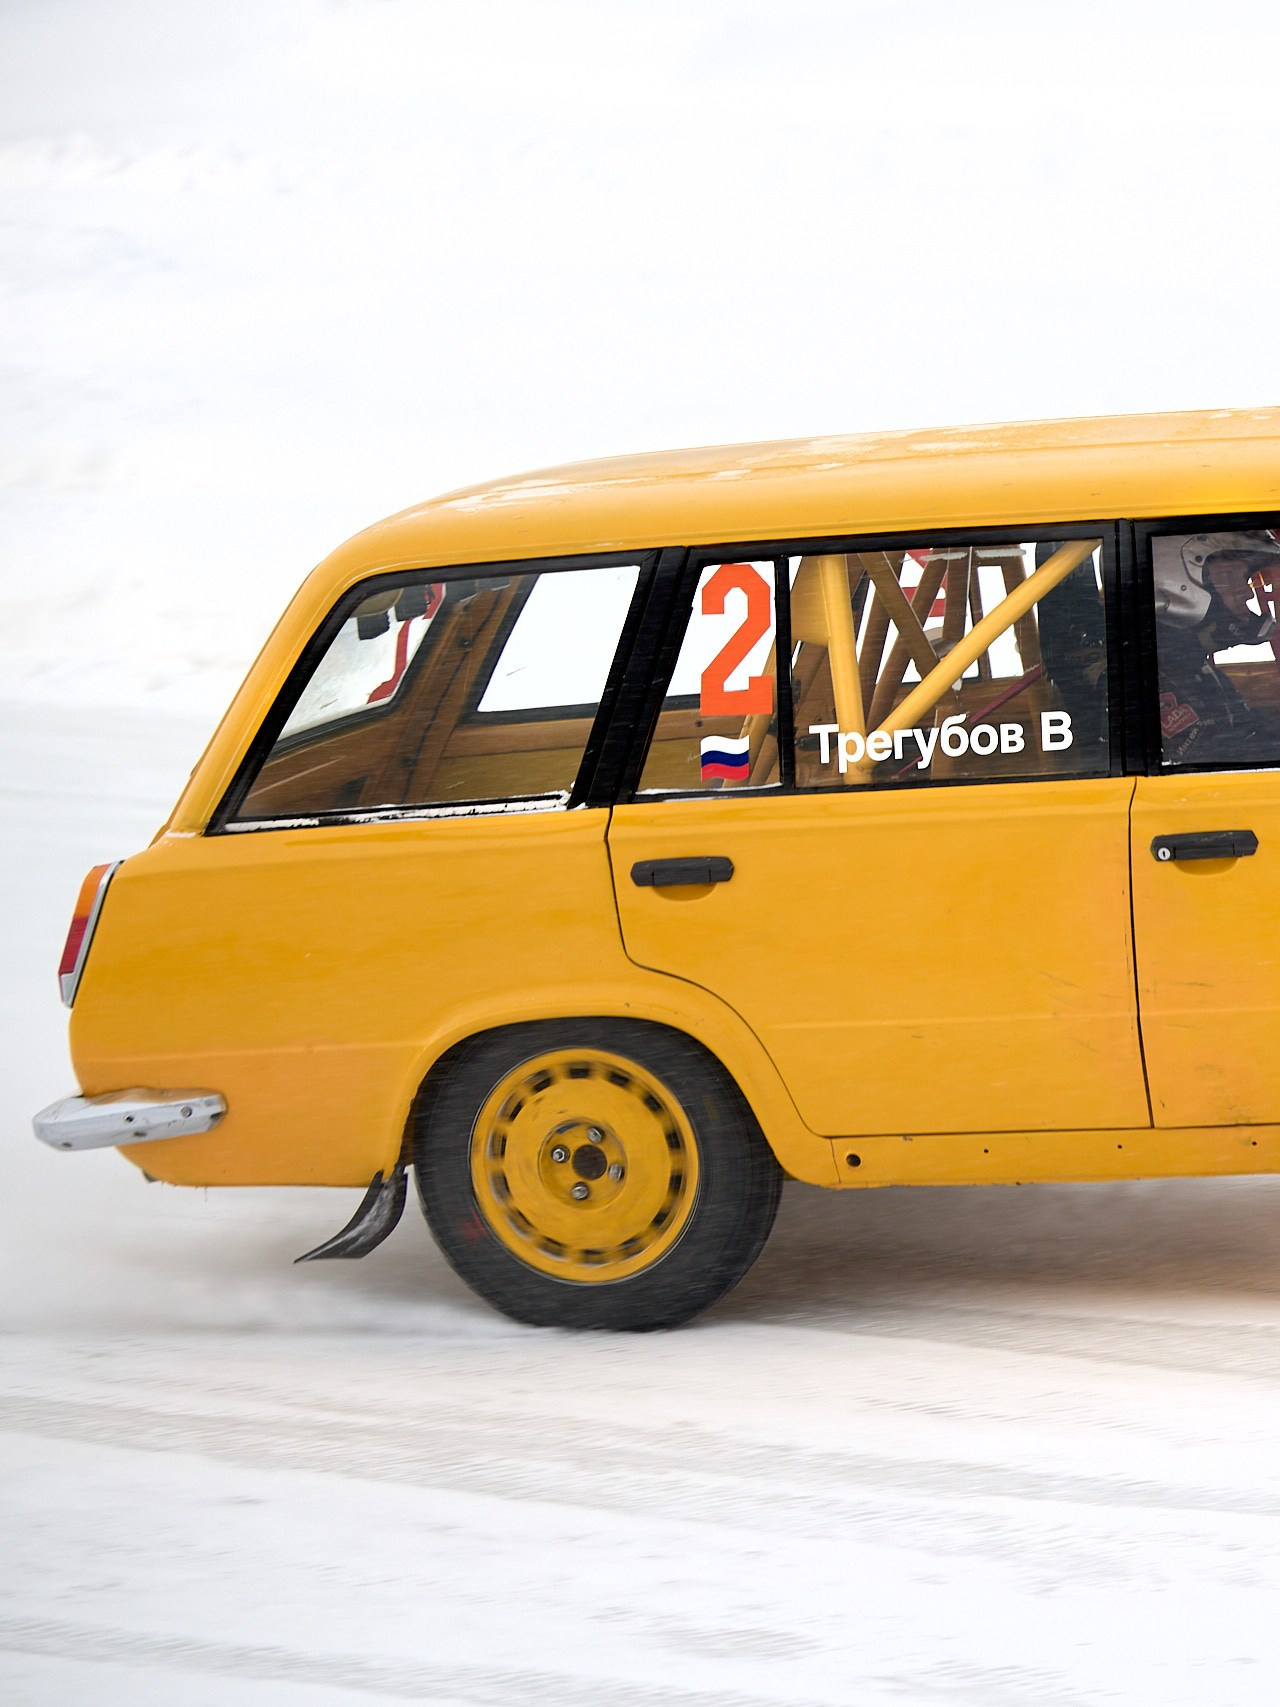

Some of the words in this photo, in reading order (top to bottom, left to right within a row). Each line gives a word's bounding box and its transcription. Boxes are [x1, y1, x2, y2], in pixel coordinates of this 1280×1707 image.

[700, 563, 773, 716] 2
[808, 713, 1026, 774] Трегубов
[1040, 711, 1074, 752] В
